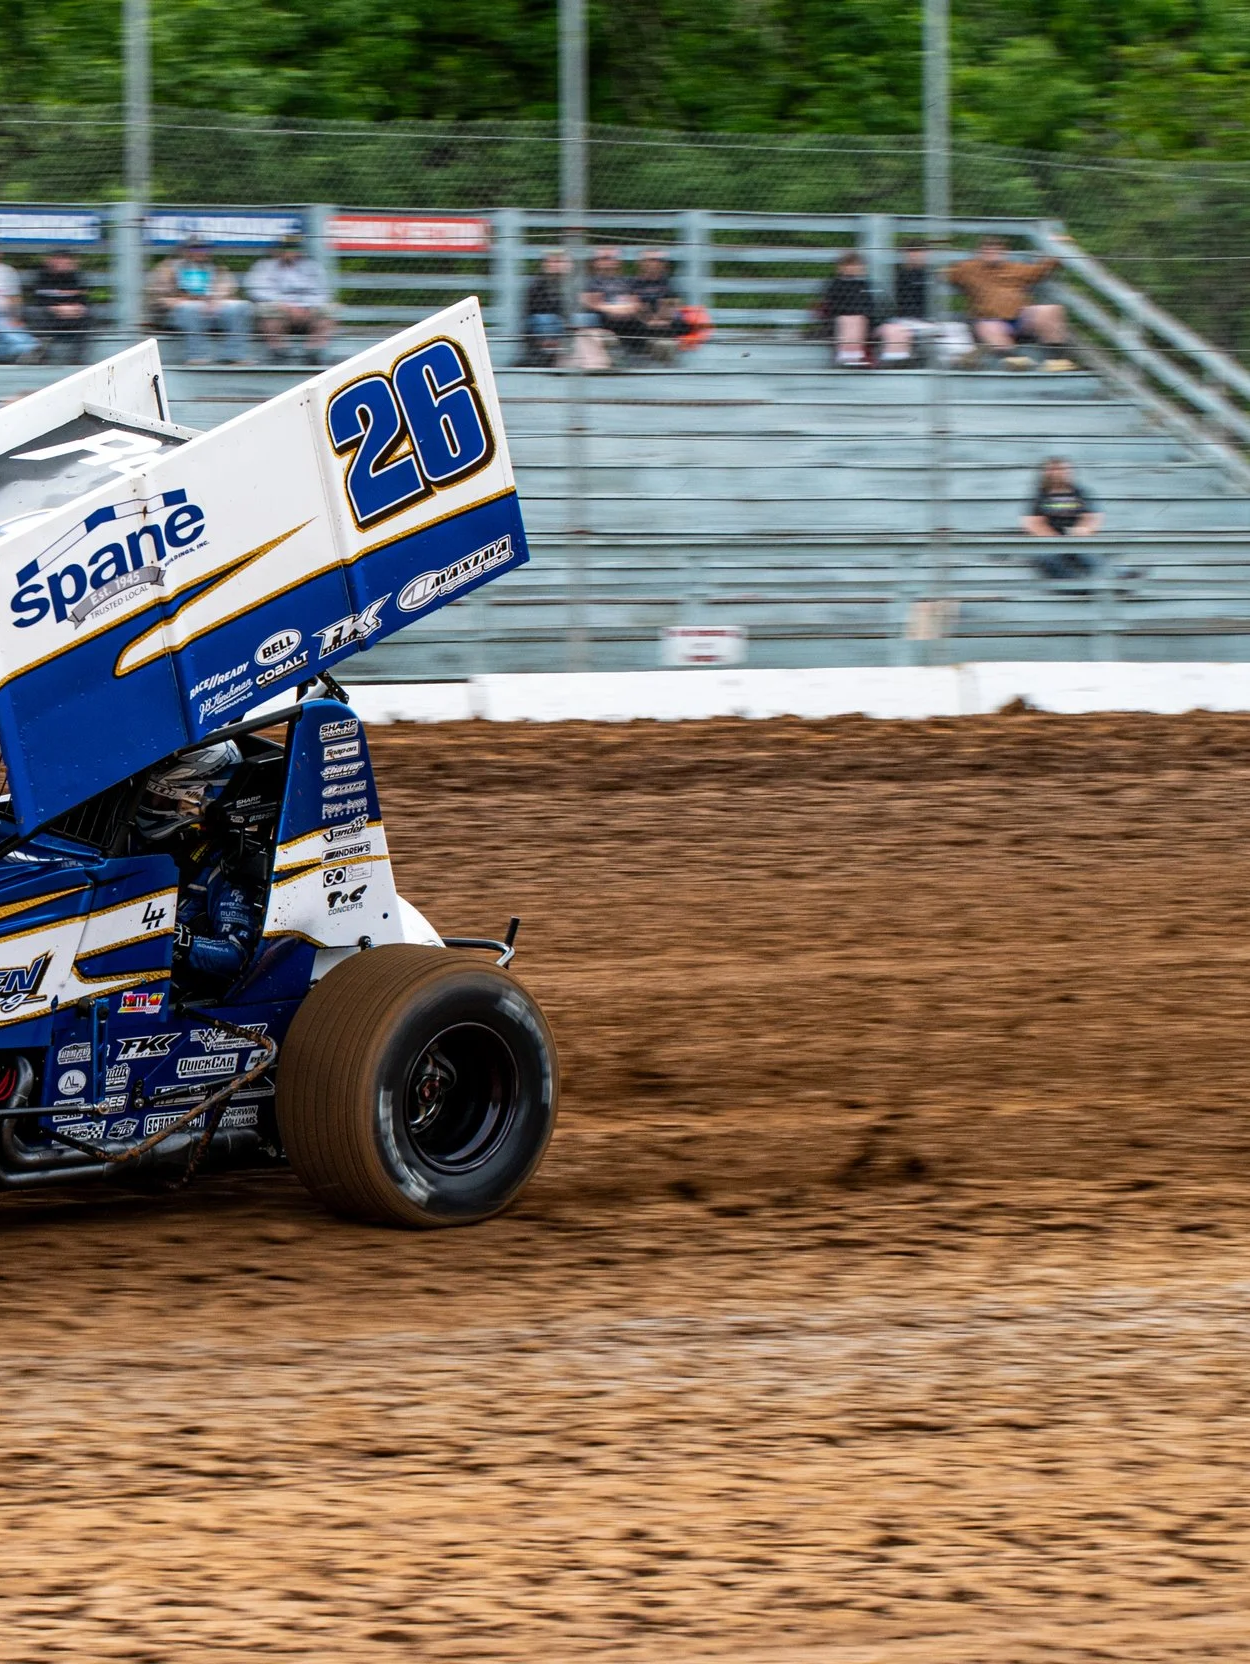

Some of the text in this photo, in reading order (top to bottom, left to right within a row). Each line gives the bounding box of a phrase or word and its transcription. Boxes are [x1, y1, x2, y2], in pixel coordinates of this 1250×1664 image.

[326, 335, 496, 533] 26
[10, 504, 206, 629] spane
[431, 537, 510, 591] MAXIMA
[90, 570, 141, 606] Est. 1945
[90, 584, 150, 620] TRUSTED LOCAL
[262, 636, 295, 660] BELL
[255, 650, 310, 686] COBALT
[320, 719, 358, 734] SHARP
[325, 745, 358, 758] Snap-on
[332, 843, 371, 859] ANDREW'S
[324, 867, 346, 887] GO
[327, 901, 364, 916] CONCEPTS
[220, 1115, 258, 1128] WILLIAMS
[223, 1105, 258, 1117] SHERWIN
